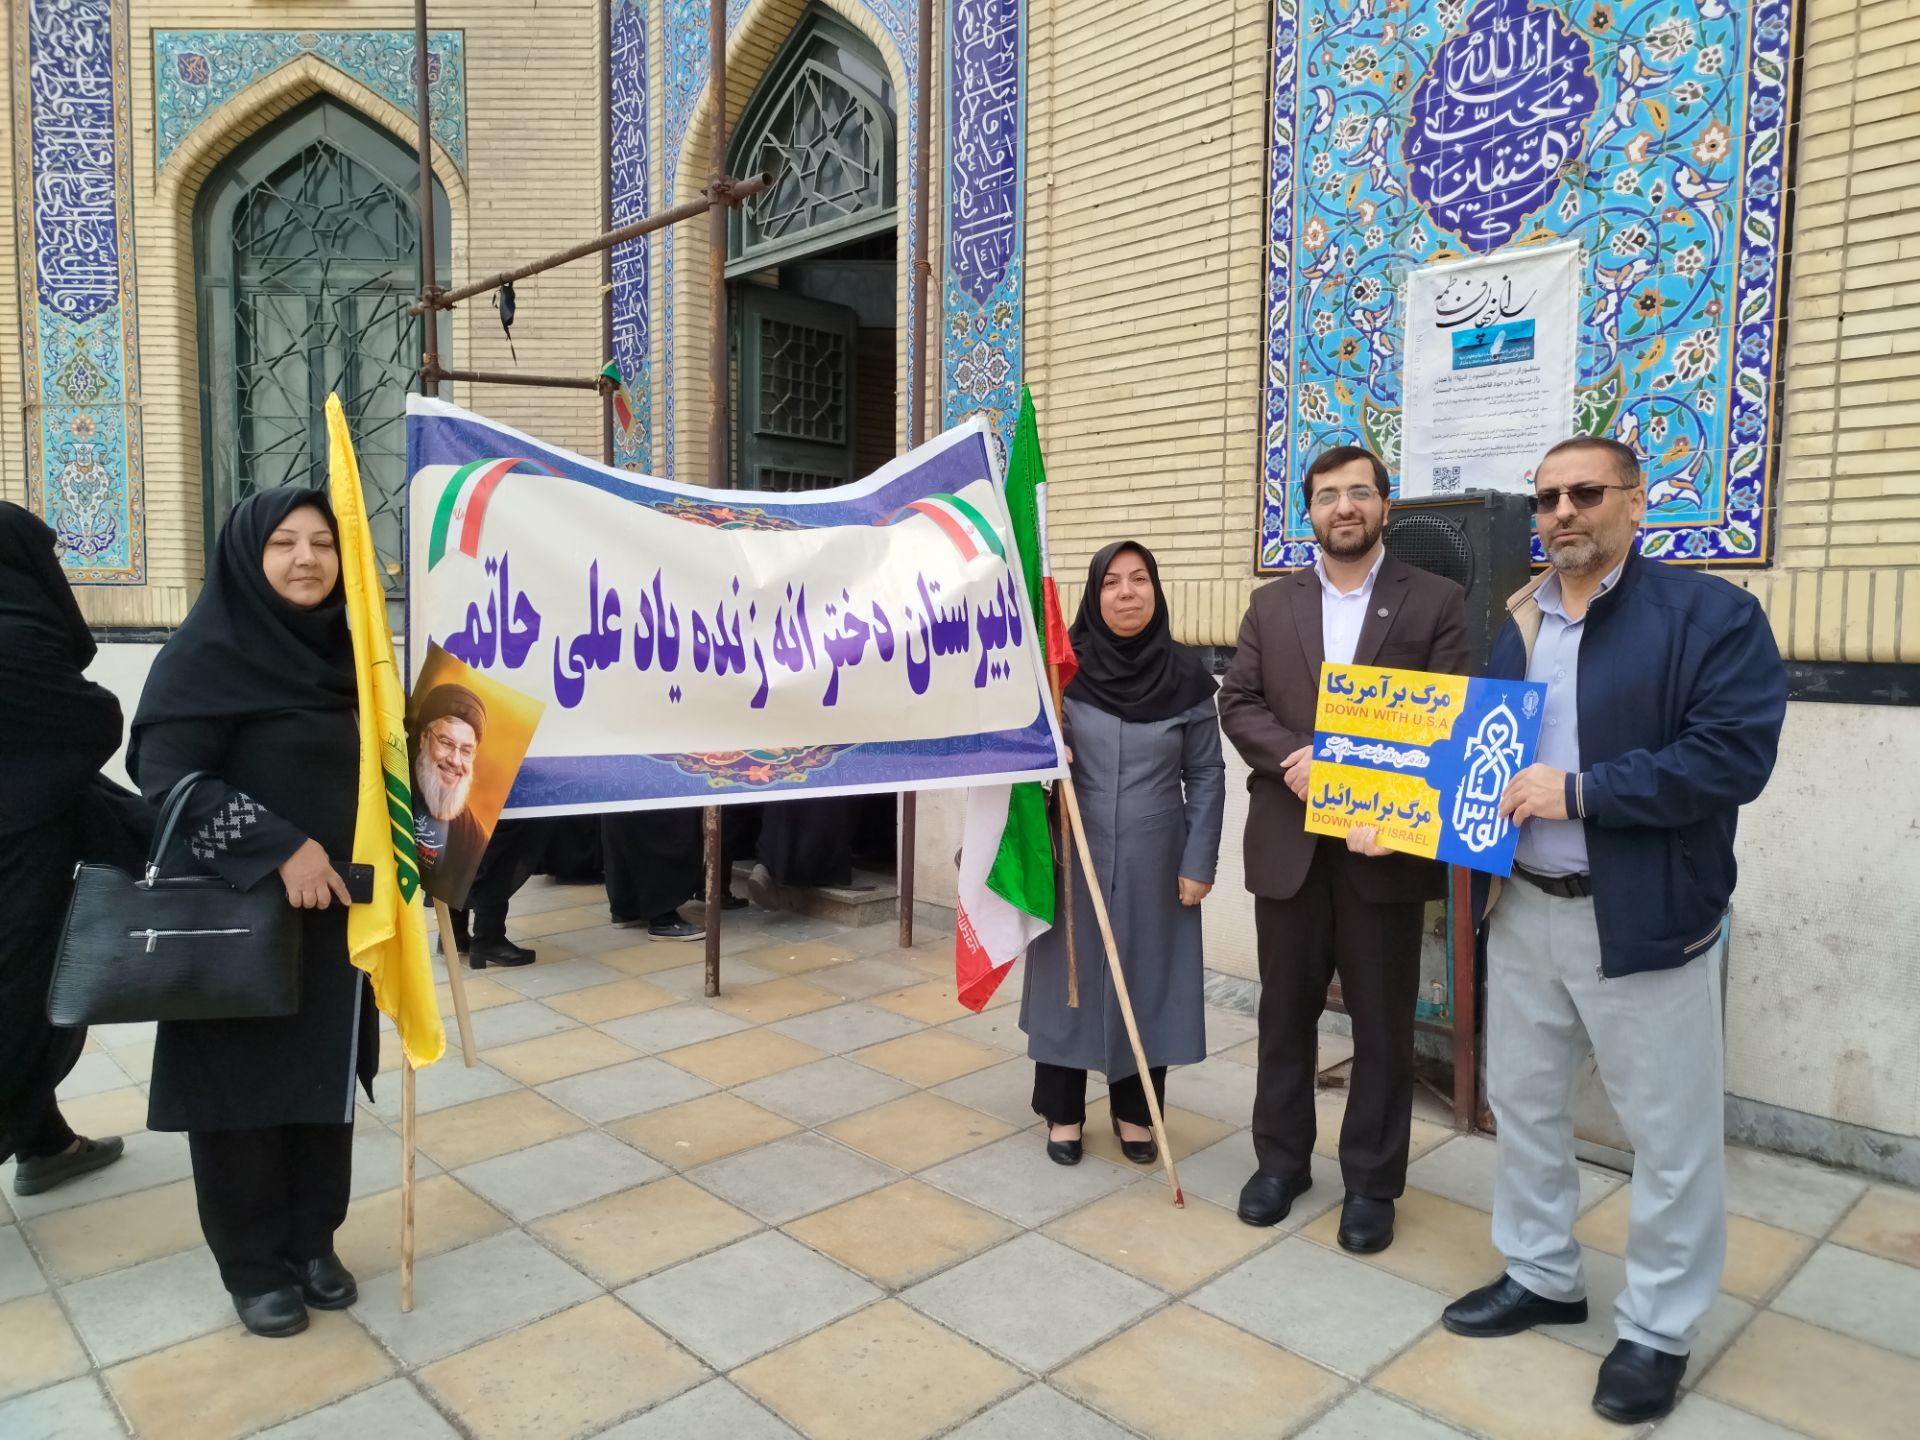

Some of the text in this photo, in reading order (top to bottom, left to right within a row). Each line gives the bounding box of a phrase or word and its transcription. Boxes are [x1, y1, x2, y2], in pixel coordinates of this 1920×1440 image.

[553, 558, 622, 708] علی
[1326, 672, 1451, 713] مرگ بر آمریکا
[1324, 702, 1448, 730] DOWN WITH U.S.A
[1312, 783, 1431, 828] مرگ بر اسرائیل
[1311, 812, 1352, 829] DOWN
[1387, 827, 1430, 846] ISRAEL
